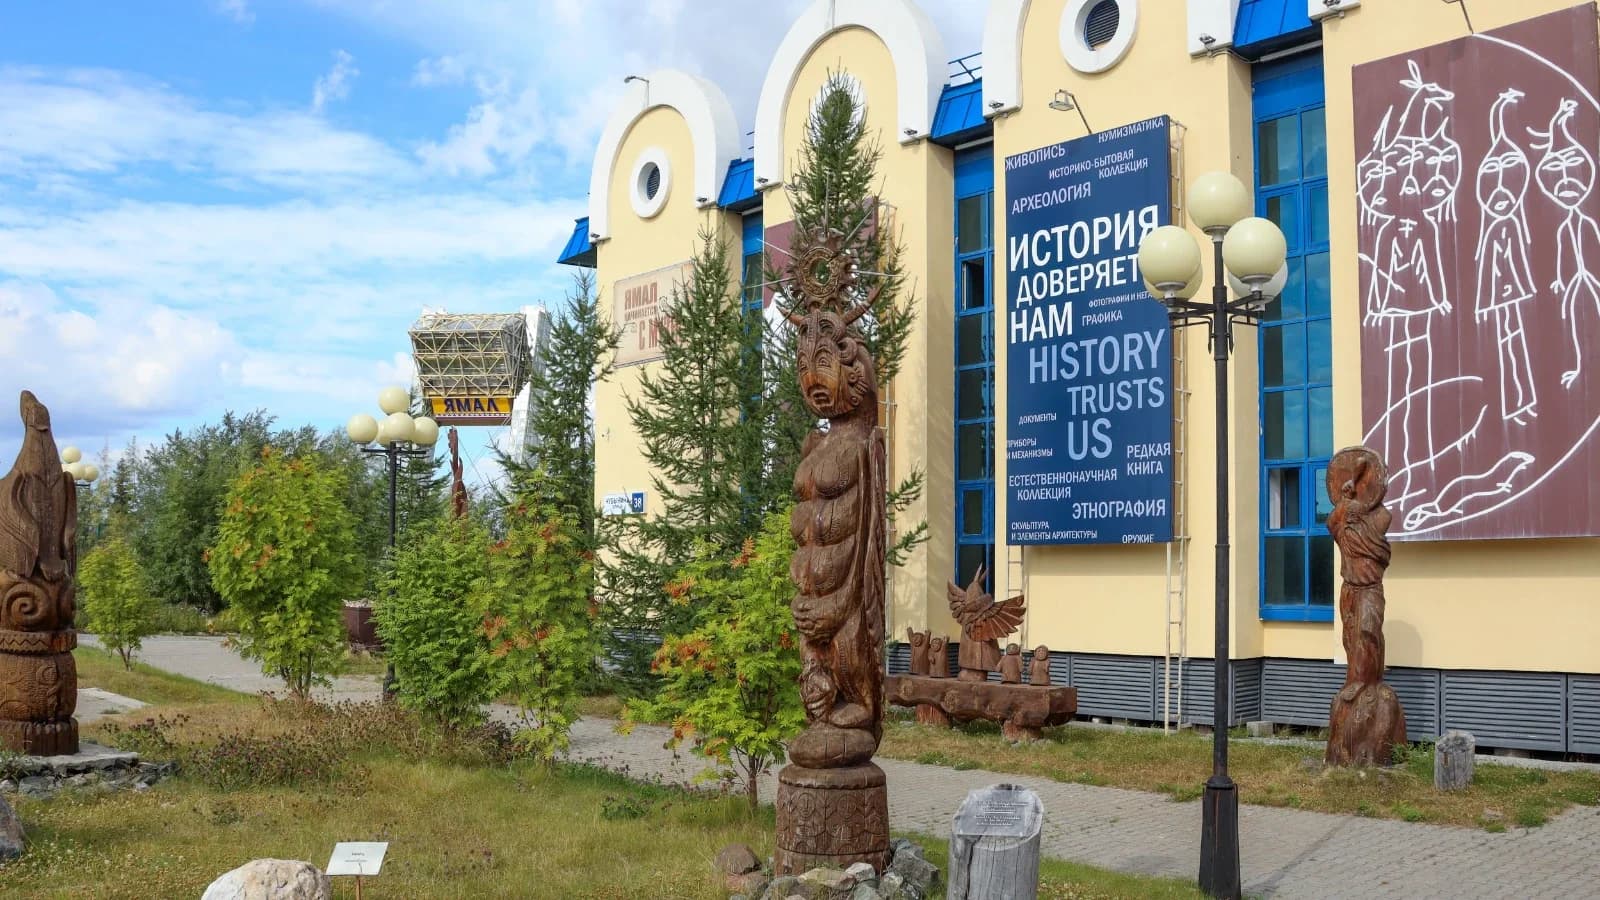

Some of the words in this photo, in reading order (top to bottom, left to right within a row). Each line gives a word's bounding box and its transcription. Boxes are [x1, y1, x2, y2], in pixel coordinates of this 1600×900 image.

[1098, 117, 1164, 144] НУМИЗМАТИКА
[1005, 144, 1066, 171] ЖИВОПИСЬ
[1049, 149, 1134, 180] ИСТОРИКО-БЫТОВАЯ
[1098, 158, 1148, 179] КОЛЛЕКЦИЯ
[1012, 181, 1092, 215] АРХЕОЛОГИЯ
[1010, 205, 1158, 272] ИСТОРИЯ
[1016, 254, 1139, 309] ДОВЕРЯЕТ
[624, 282, 658, 311] ЯМАЛ
[1088, 294, 1130, 308] ФОТОГРАФИИ
[1130, 292, 1135, 301] И
[1136, 290, 1153, 301] НЕГА
[1010, 301, 1073, 344] НАМ
[1082, 309, 1123, 327] ГРАФИКА
[639, 319, 646, 351] С
[1029, 328, 1166, 384] HISTORY
[444, 397, 499, 412] ЯМАЛ
[1067, 376, 1165, 416] TRUSTS
[1018, 412, 1057, 426] ДОКУМЕНТЫ
[1007, 437, 1037, 449] ПРИБОРЫ
[1067, 417, 1113, 461] US
[1011, 448, 1053, 461] МЕХАНИЗМЫ
[1127, 442, 1171, 459] РЕДКАЯ
[1009, 468, 1118, 487] ЕСТЕСТВЕННОНАУЧНАЯ
[1127, 461, 1164, 477] КНИГА
[633, 497, 642, 508] 38
[1017, 487, 1071, 502] КОЛЛЕКЦИЯ
[1072, 499, 1166, 520] ЭТНОГРАФИЯ
[1011, 521, 1050, 530] СКУЛЬПТУРА
[1011, 532, 1016, 541] И
[1017, 531, 1051, 541] ЭЛЕМЕНТЫ
[1051, 530, 1098, 540] АРХИТЕКТУРЫ
[1122, 533, 1154, 544] ОРУЖИЕ
